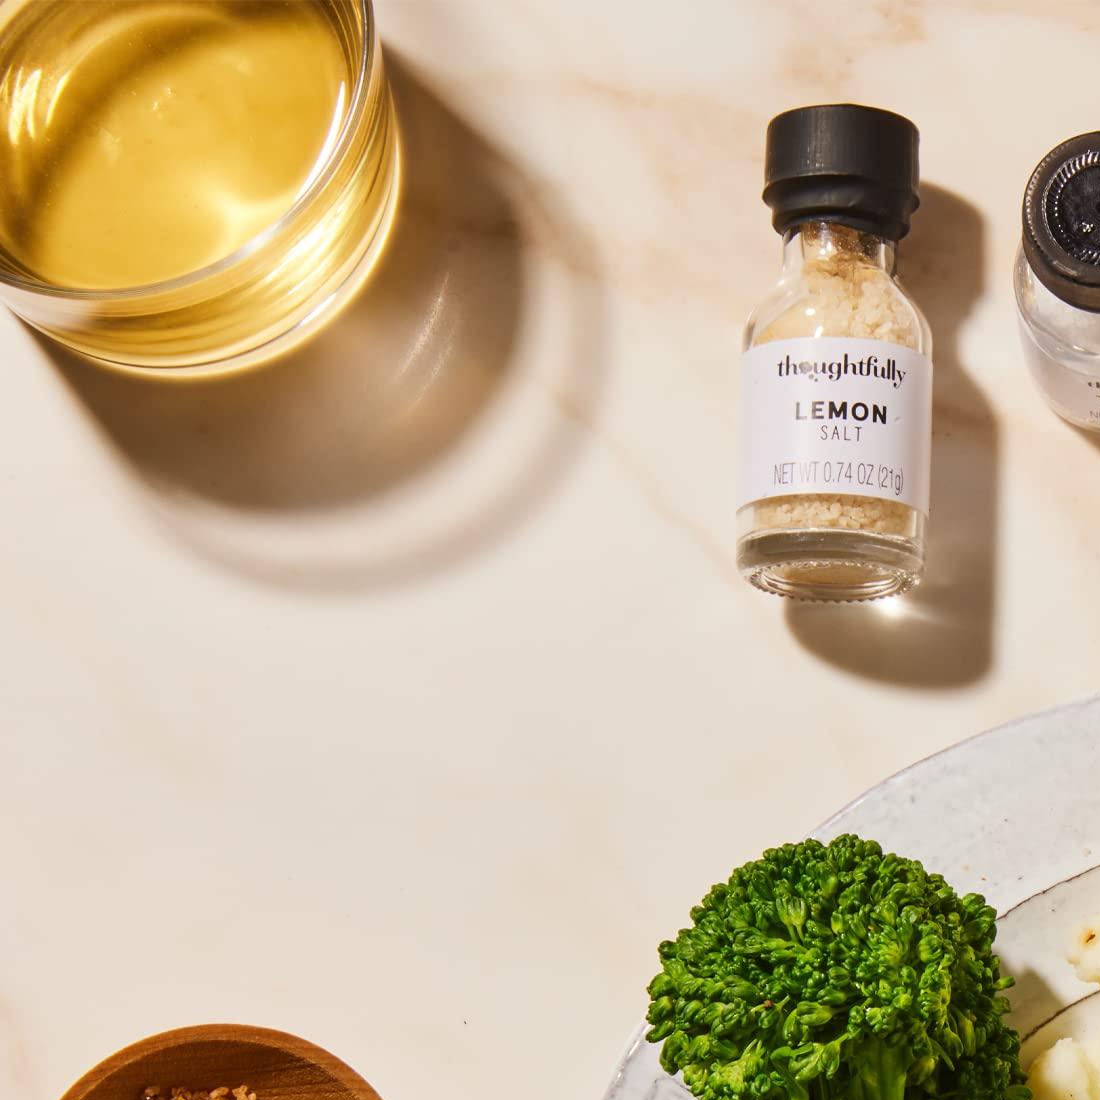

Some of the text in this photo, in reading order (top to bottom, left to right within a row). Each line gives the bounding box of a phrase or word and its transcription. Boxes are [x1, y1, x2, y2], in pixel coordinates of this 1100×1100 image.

[795, 401, 887, 425] LEMON
[820, 425, 863, 442] SALT
[773, 461, 904, 496] NET WT 0.74 OZ (21g)
